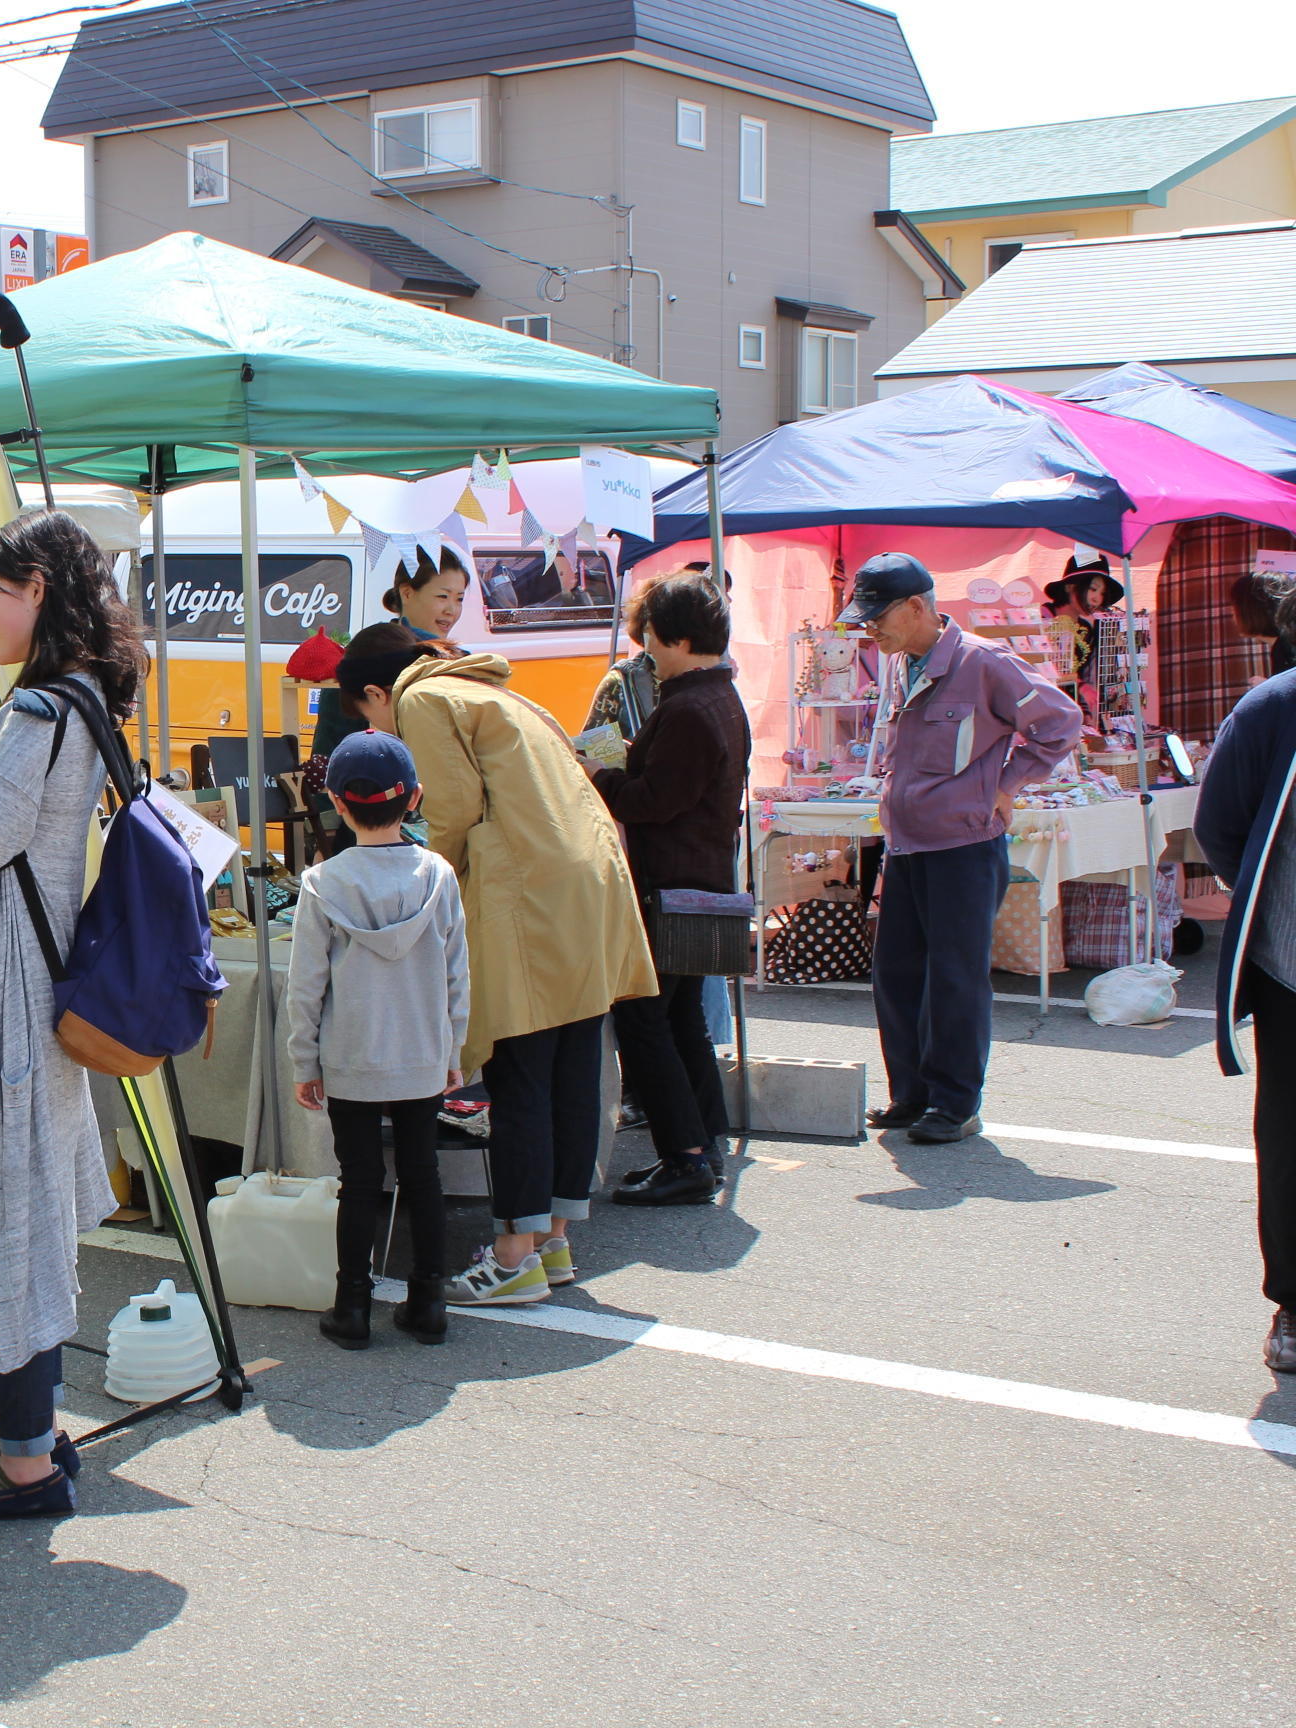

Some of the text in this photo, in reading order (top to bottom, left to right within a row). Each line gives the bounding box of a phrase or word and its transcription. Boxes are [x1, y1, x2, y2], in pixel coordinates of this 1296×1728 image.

[10, 249, 27, 260] ERA
[264, 582, 343, 628] Cafe
[279, 770, 309, 813] Y
[466, 1269, 495, 1292] N
